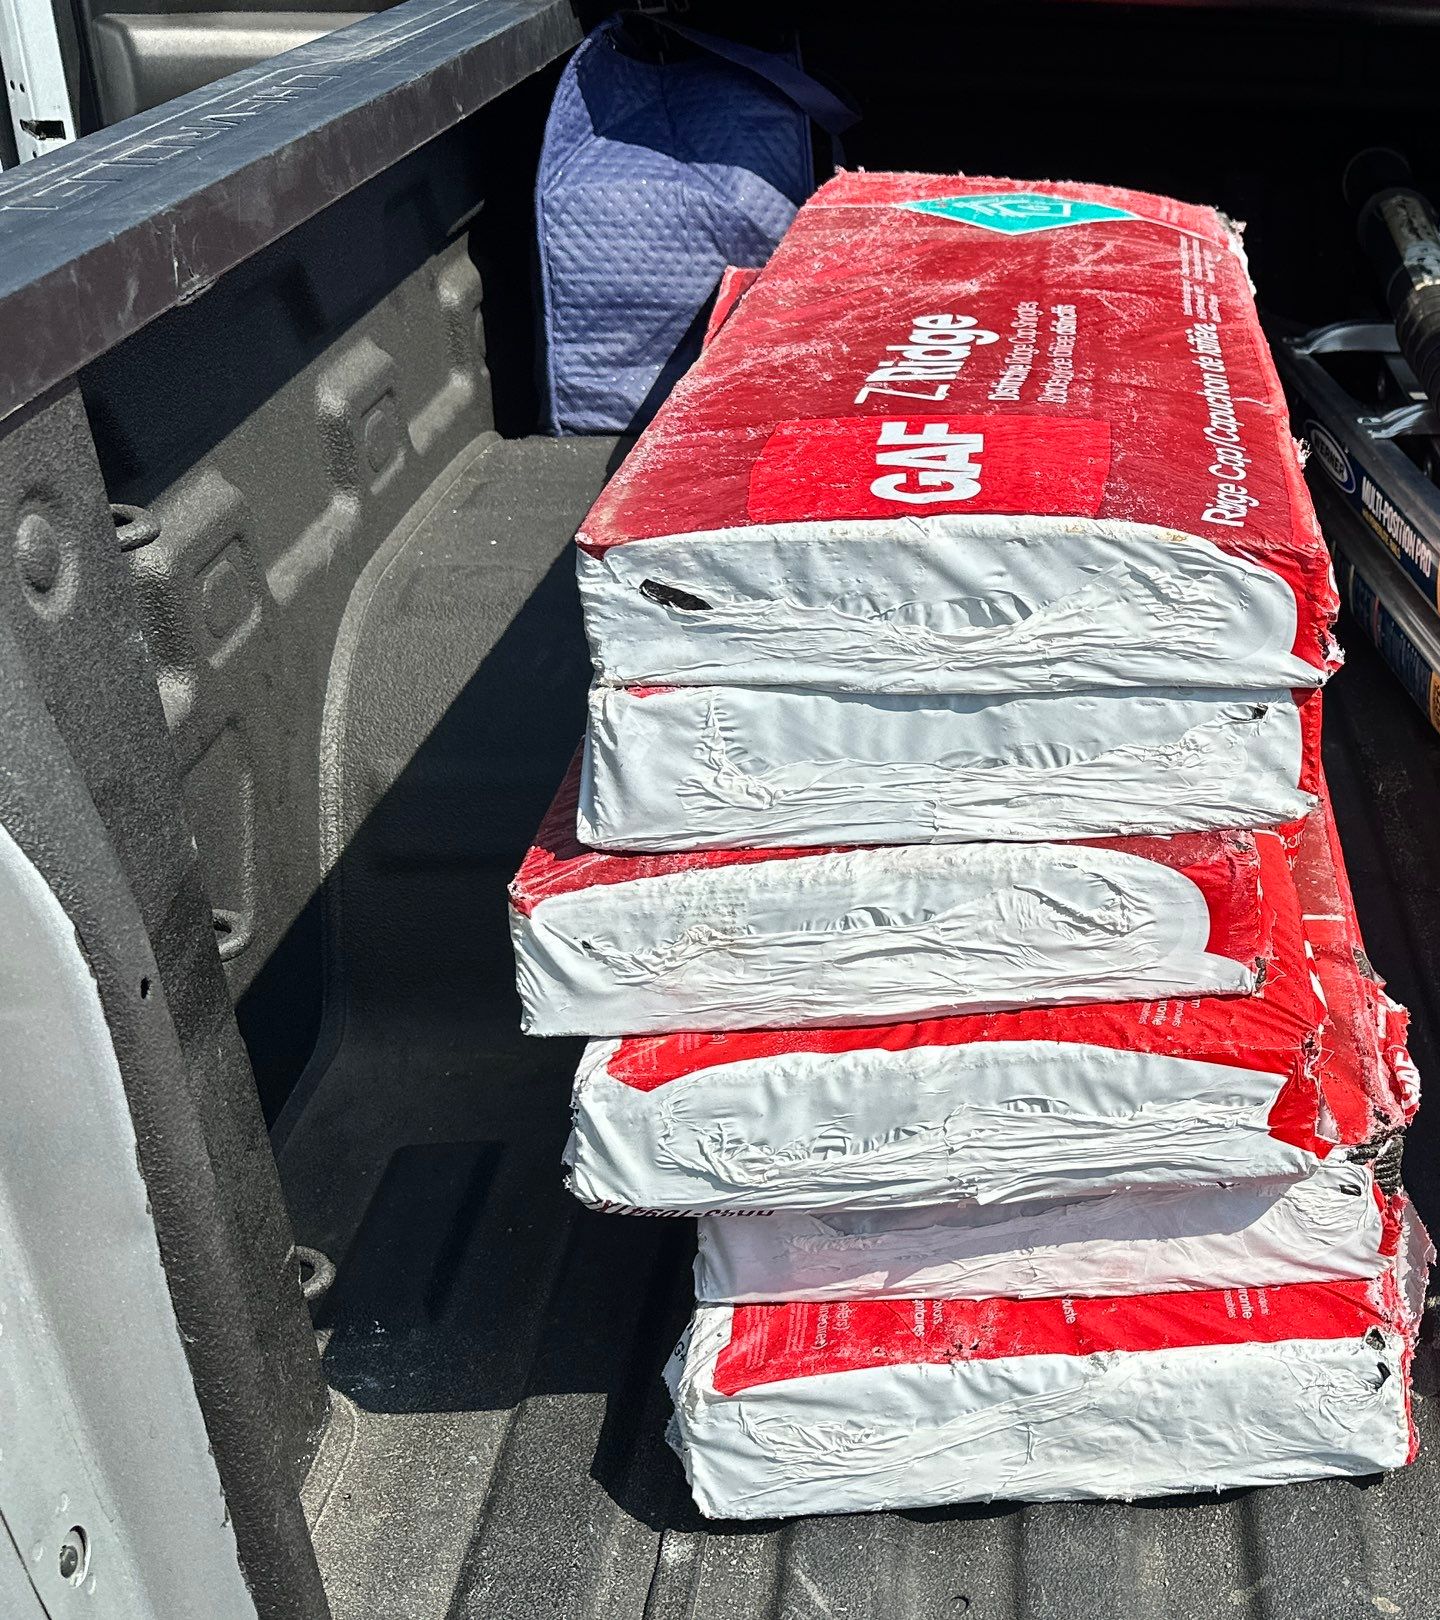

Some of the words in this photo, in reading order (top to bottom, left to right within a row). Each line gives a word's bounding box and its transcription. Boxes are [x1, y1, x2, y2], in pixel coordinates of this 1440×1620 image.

[1010, 301, 1044, 329] Shingles
[866, 313, 1000, 382] Ridge
[1008, 328, 1043, 344] Cap
[1004, 344, 1040, 364] Ridge
[1191, 354, 1226, 373] de
[987, 365, 1033, 401] Distinctive
[870, 421, 984, 504] GAF
[1201, 483, 1260, 527] Ridge
